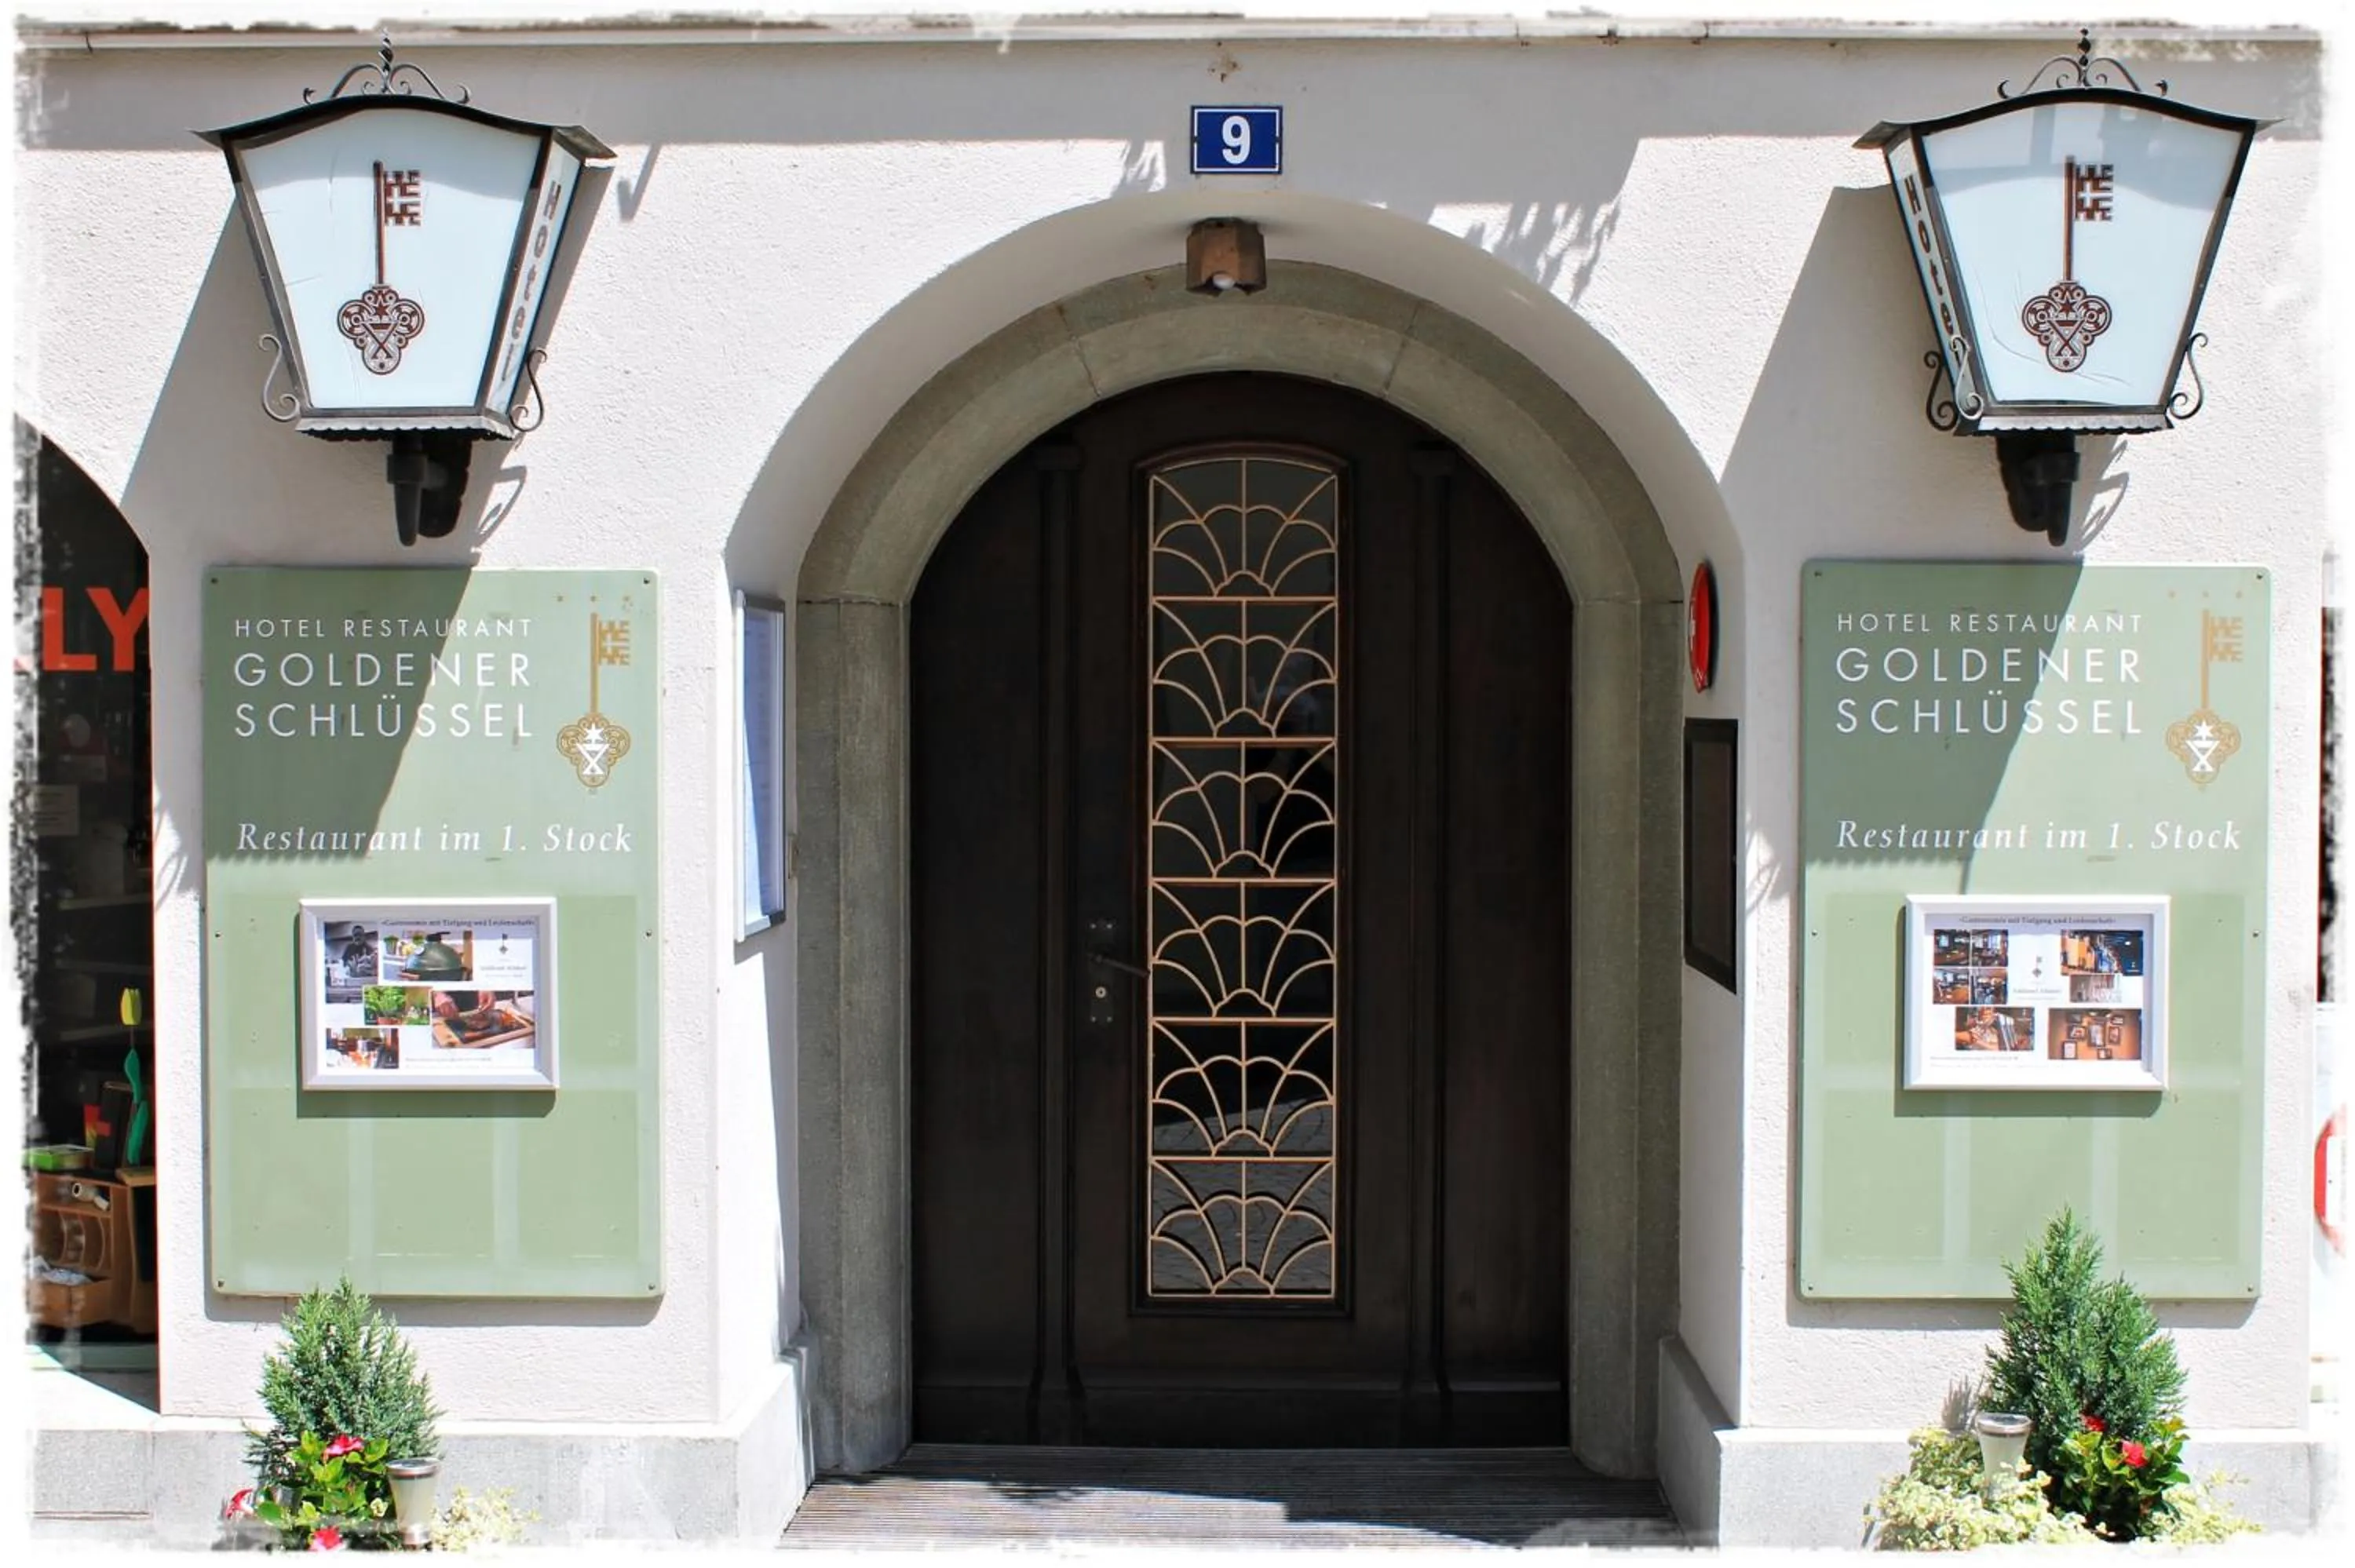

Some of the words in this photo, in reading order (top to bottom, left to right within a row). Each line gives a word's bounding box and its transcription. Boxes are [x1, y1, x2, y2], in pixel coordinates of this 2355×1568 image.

[1221, 115, 1251, 165] 9
[14, 586, 150, 673] LY
[235, 618, 325, 638] HOTEL
[345, 618, 531, 638] RESTAURANT
[1838, 613, 1930, 633] HOTEL
[1951, 613, 2141, 633] RESTAURANT
[235, 652, 530, 687] GOLDENER
[1836, 647, 2140, 683] GOLDENER
[235, 694, 532, 738] SCHLÜSSEL
[1836, 689, 2141, 734] SCHLÜSSEL
[238, 822, 422, 851] Restaurant
[440, 823, 480, 851] im
[502, 824, 527, 851] 1.
[542, 822, 632, 852] Stock
[1836, 819, 2028, 849] Restaurant
[2045, 821, 2087, 849] im
[2109, 822, 2134, 849] 1.
[2151, 820, 2241, 850] Stock
